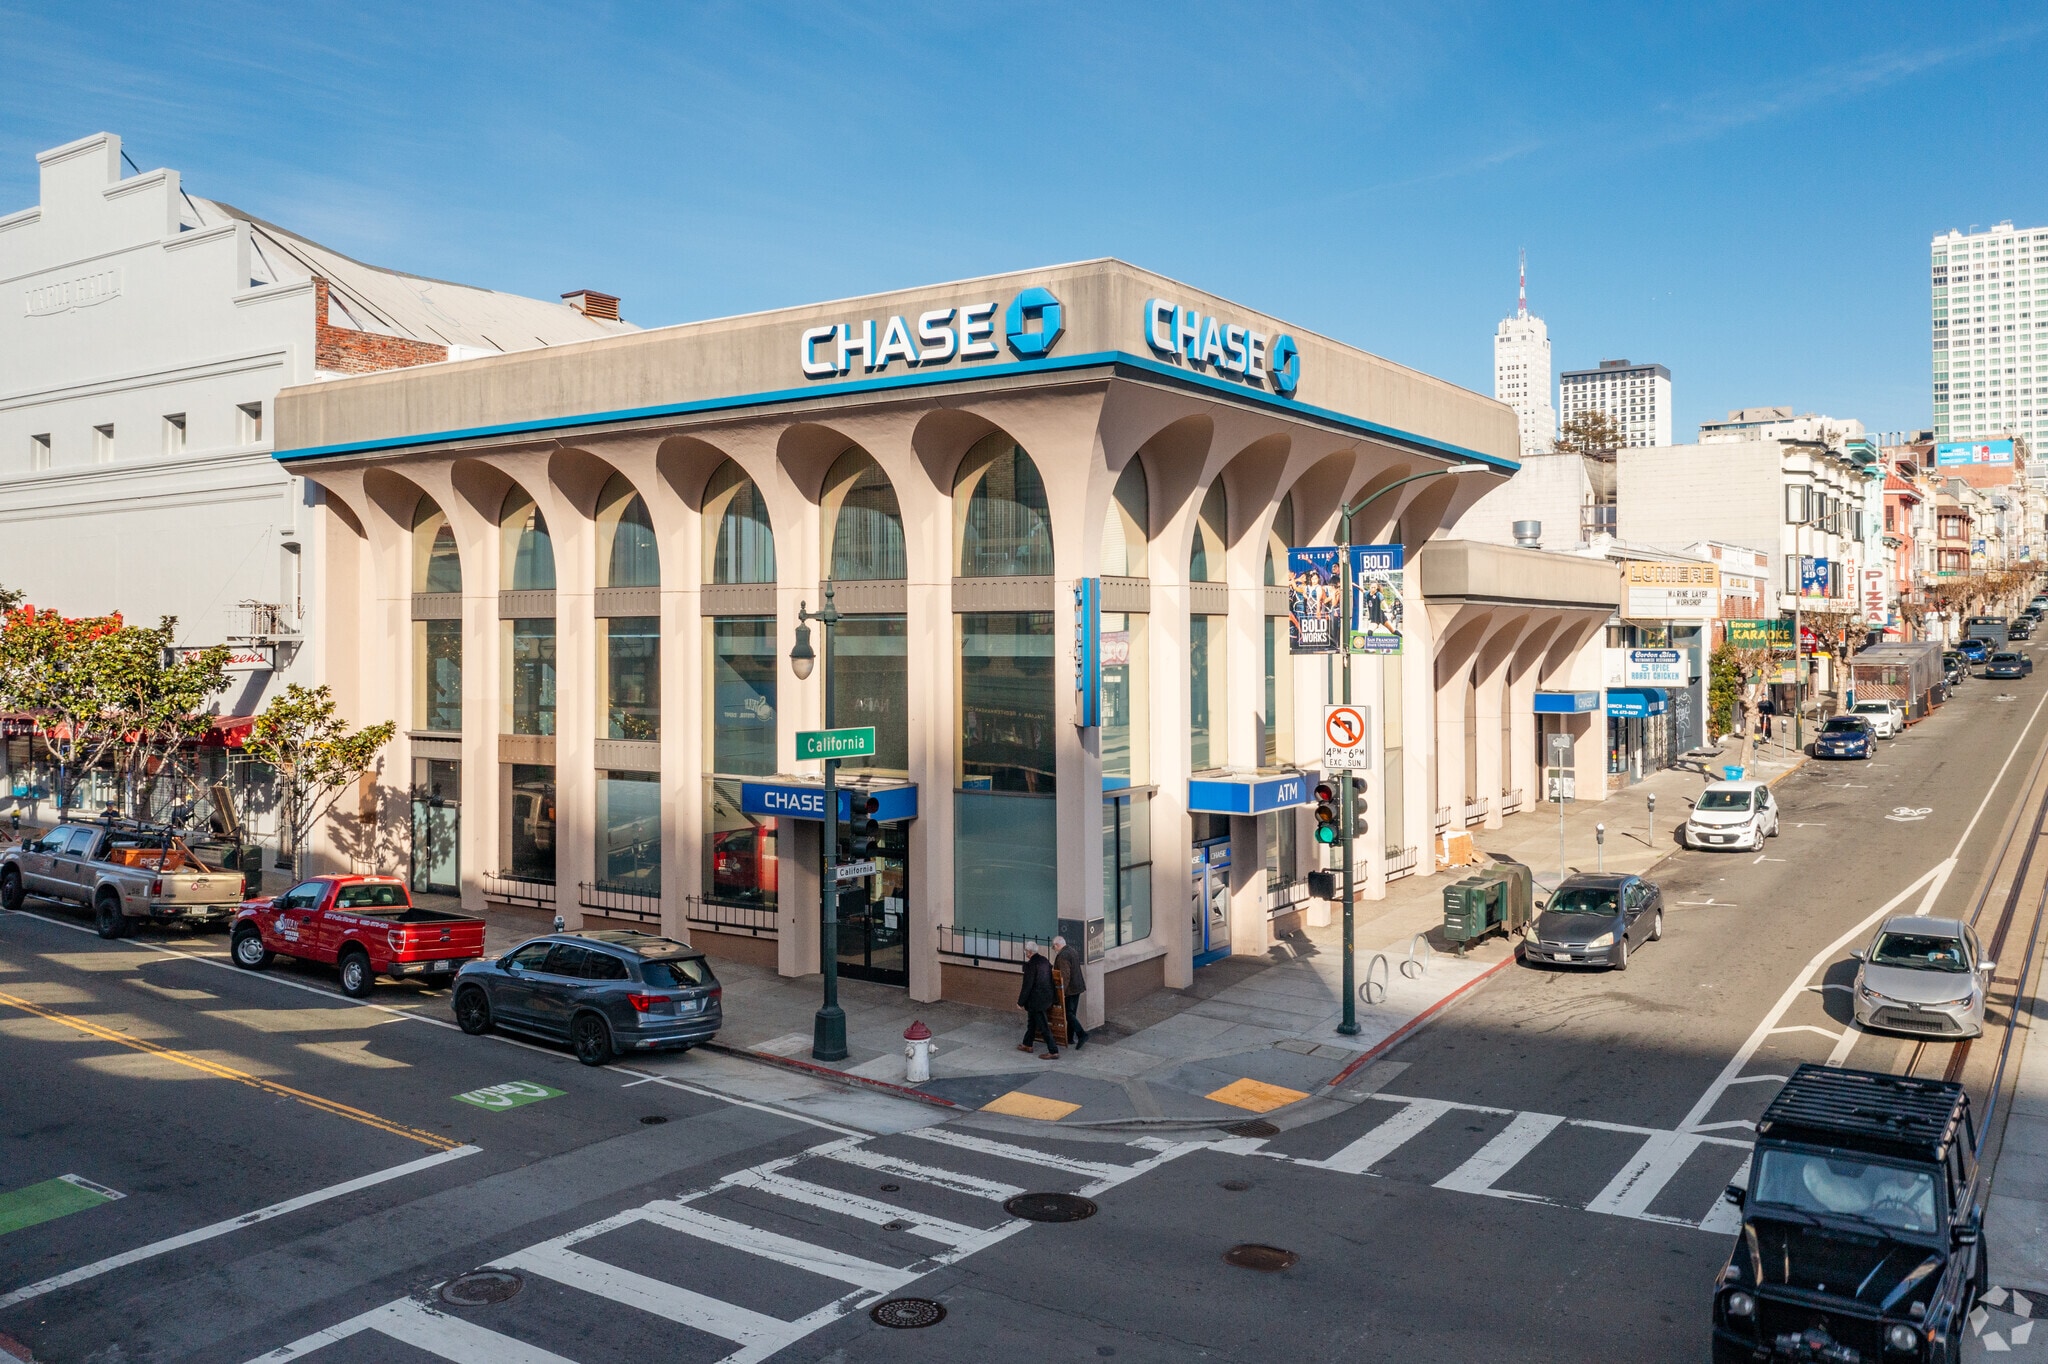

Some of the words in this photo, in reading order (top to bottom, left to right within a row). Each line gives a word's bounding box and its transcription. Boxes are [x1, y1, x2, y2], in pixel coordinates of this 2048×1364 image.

[801, 302, 999, 377] CHASE
[1144, 298, 1268, 381] CHASE
[1363, 555, 1390, 569] BOLD
[1363, 569, 1390, 581] PLAYS
[1631, 565, 1714, 584] LUMIERE
[1847, 558, 1855, 600] HOTEL
[1668, 590, 1688, 598] MARINE
[1692, 590, 1708, 598] LAYER
[1865, 570, 1883, 622] PIZZA
[1676, 598, 1702, 606] WORKSHOP
[1301, 619, 1327, 632] BOLD
[1730, 621, 1756, 629] Encore
[1302, 632, 1328, 643] WORKS
[1733, 629, 1791, 640] KARAOKE
[1653, 672, 1680, 680] CHICKEN
[807, 734, 865, 753] California
[1326, 747, 1342, 758] 4PM
[1348, 748, 1365, 759] 6PM
[1329, 758, 1342, 766] EXC
[1348, 759, 1361, 767] SUN
[1277, 781, 1298, 803] ATM
[764, 791, 825, 813] CHASE
[1210, 849, 1226, 860] CHASE
[140, 858, 170, 866] RIDGD
[839, 864, 873, 878] California
